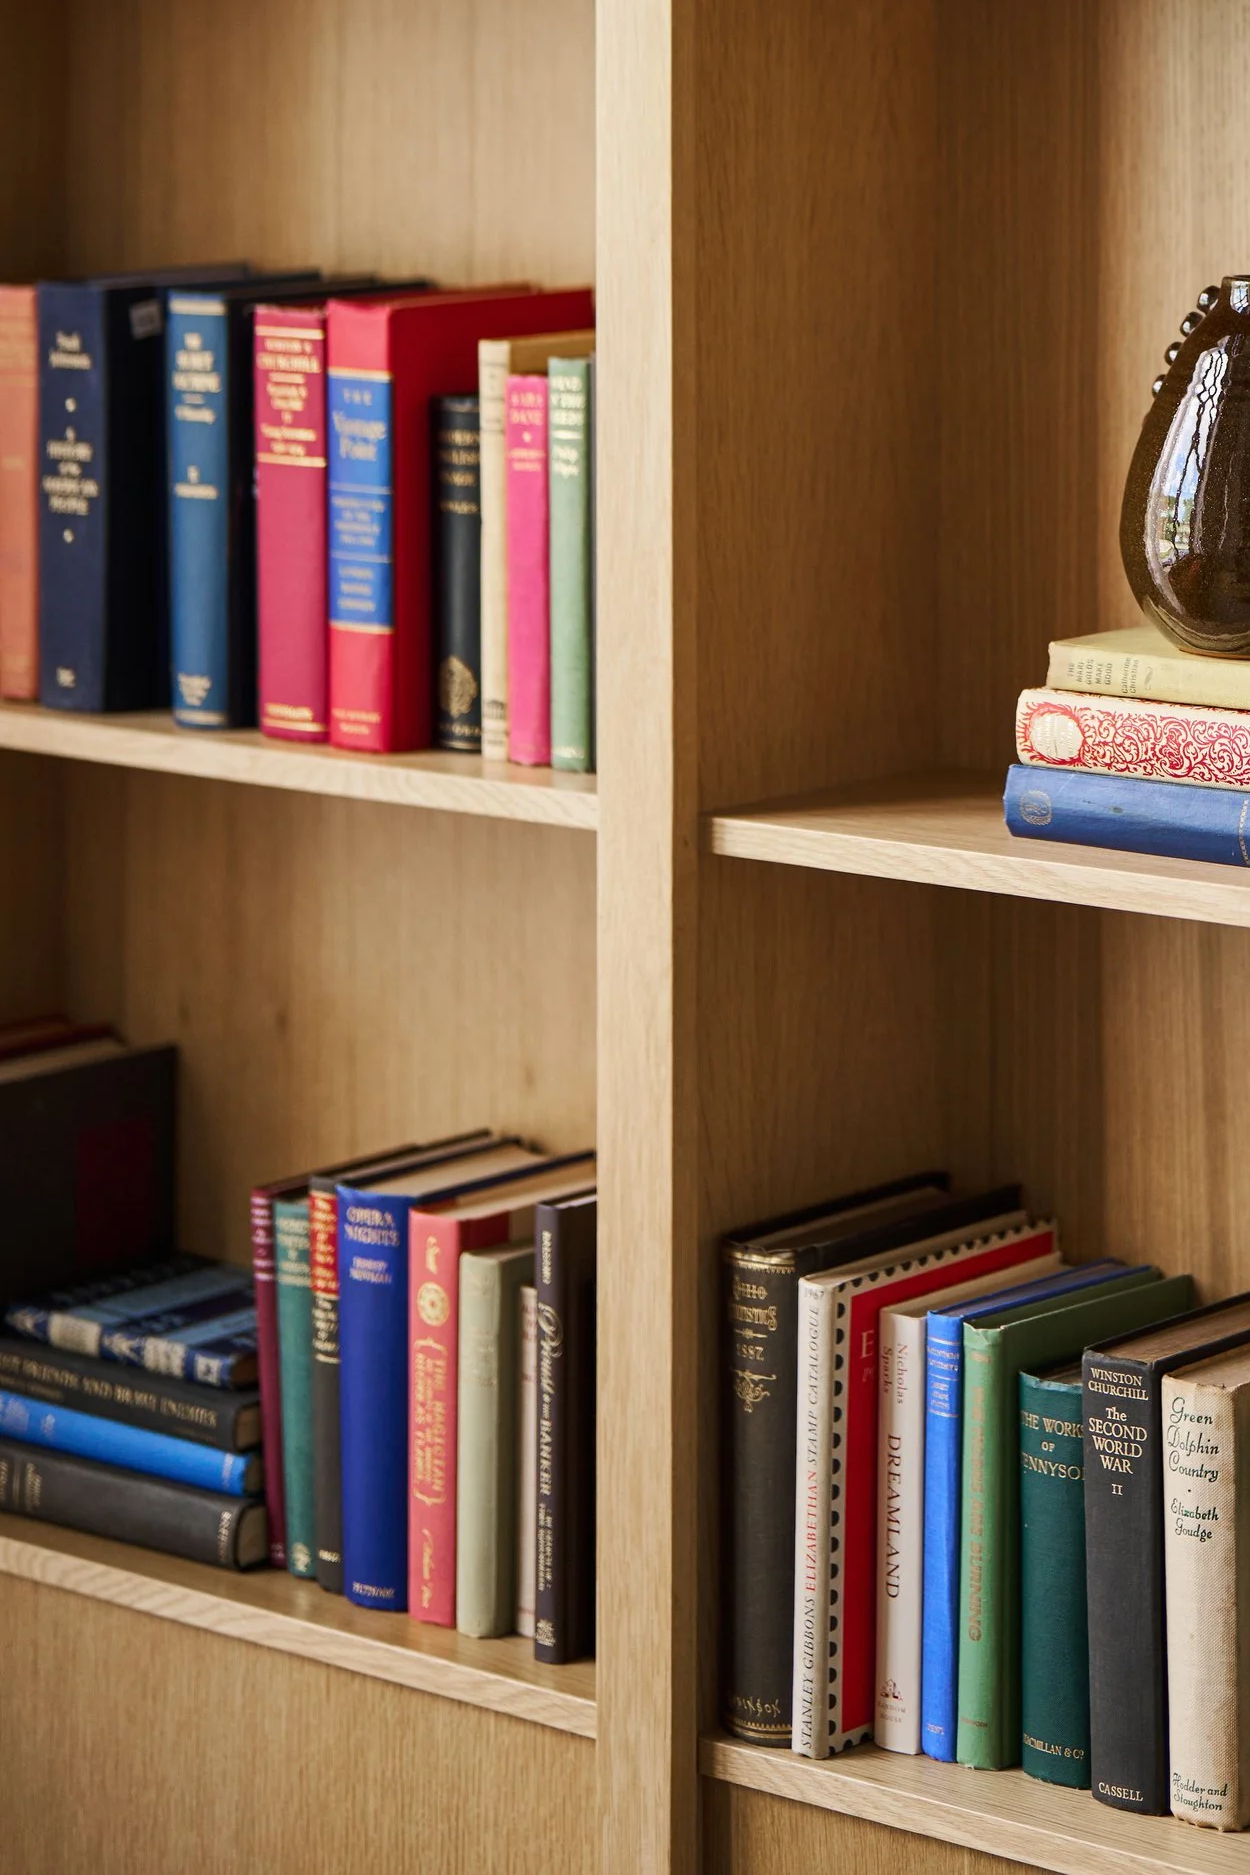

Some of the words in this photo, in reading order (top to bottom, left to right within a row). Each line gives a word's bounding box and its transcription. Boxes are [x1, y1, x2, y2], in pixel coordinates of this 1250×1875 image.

[1067, 662, 1075, 677] THE
[1086, 658, 1096, 685] GOLDS
[1095, 663, 1104, 685] MAKE
[1104, 662, 1113, 686] GOOD
[1122, 657, 1132, 694] Catherine
[1130, 659, 1140, 694] Christian
[807, 1305, 820, 1406] CATALOGUE
[881, 1346, 893, 1395] Sparks
[896, 1343, 908, 1405] Nicholas
[1090, 1367, 1143, 1387] WINSTON
[1088, 1379, 1149, 1401] CHURCHILL
[1105, 1406, 1127, 1422] The
[1169, 1396, 1214, 1425] Green
[806, 1408, 818, 1467] STAMP
[1043, 1416, 1085, 1439] WORKS
[1089, 1416, 1148, 1442] SECOND
[1166, 1424, 1220, 1457] Dolphin
[540, 1419, 553, 1496] BANKER
[1041, 1441, 1055, 1452] OF
[1092, 1435, 1143, 1458] WORLD
[1100, 1454, 1134, 1475] WAR
[1168, 1450, 1220, 1483] Country
[1111, 1483, 1123, 1496] II
[885, 1434, 902, 1602] DREAMLAND
[1170, 1497, 1220, 1522] Elizabeth
[804, 1469, 817, 1593] ELIZABETHAN
[1174, 1518, 1213, 1543] Goudge
[968, 1541, 984, 1643] BURNING
[803, 1595, 816, 1671] GIBBONS
[800, 1672, 815, 1751] STANLEY
[1063, 1747, 1071, 1759] &
[1098, 1781, 1144, 1802] CASSELL
[1172, 1772, 1206, 1795] Hodder
[1207, 1782, 1229, 1798] and
[1173, 1789, 1223, 1812] Stoughton
